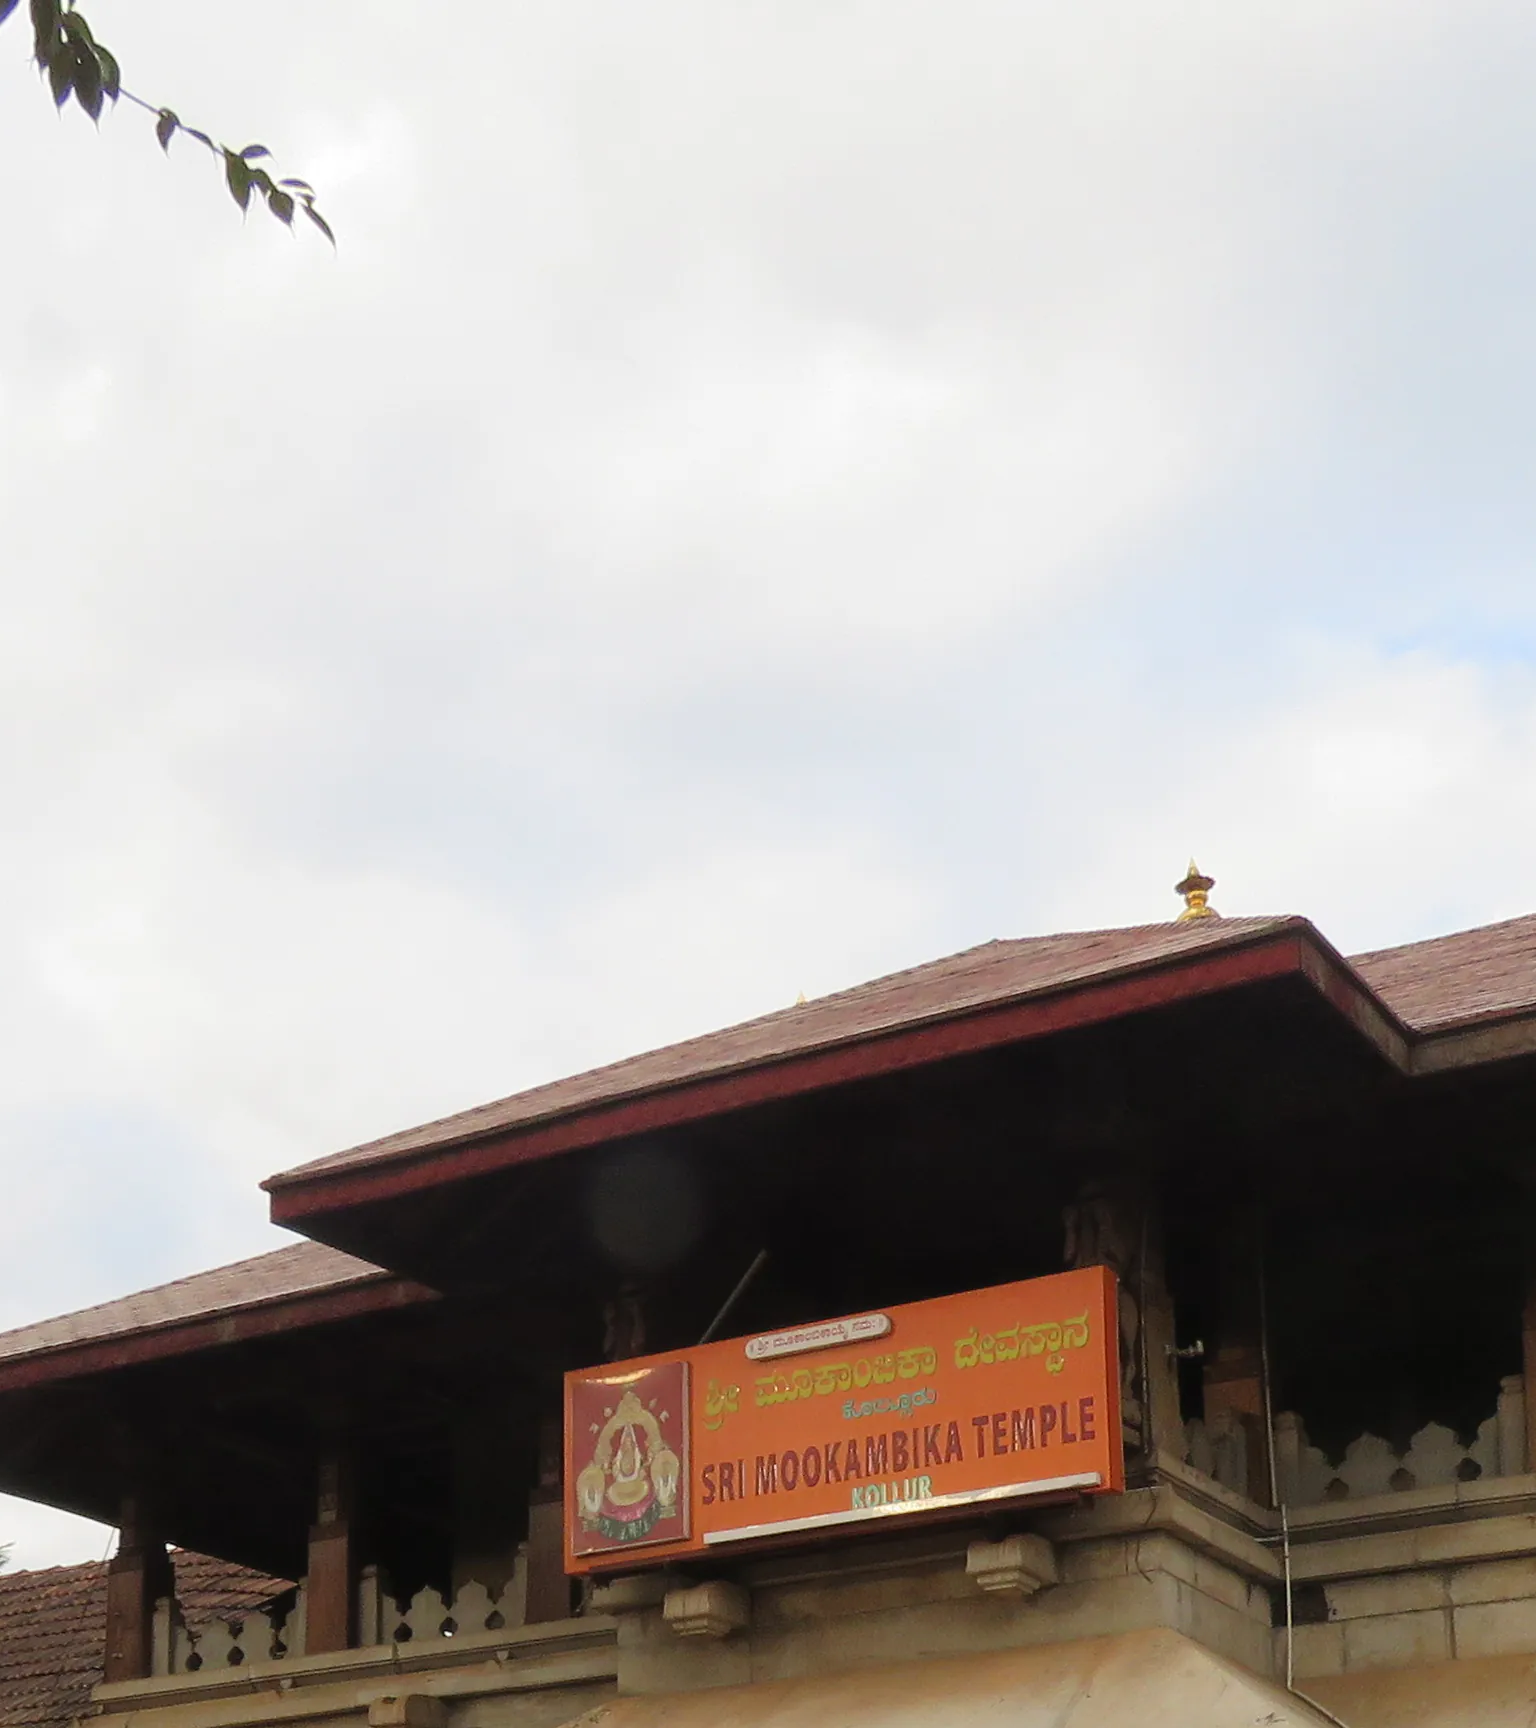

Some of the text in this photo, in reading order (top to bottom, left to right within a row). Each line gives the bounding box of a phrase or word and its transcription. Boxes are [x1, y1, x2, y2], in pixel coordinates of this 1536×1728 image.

[703, 1309, 1090, 1431] ಶ್ರೀ ಮೂಕಾಂಬಿಕಾ ದೇವಸ್ಥಾನ
[841, 1387, 937, 1421] ಕೊಲ್ಲೂರು
[702, 1396, 1096, 1506] SRI MOOKAMBIKA TEMPLE
[851, 1475, 933, 1510] KOLLUR
